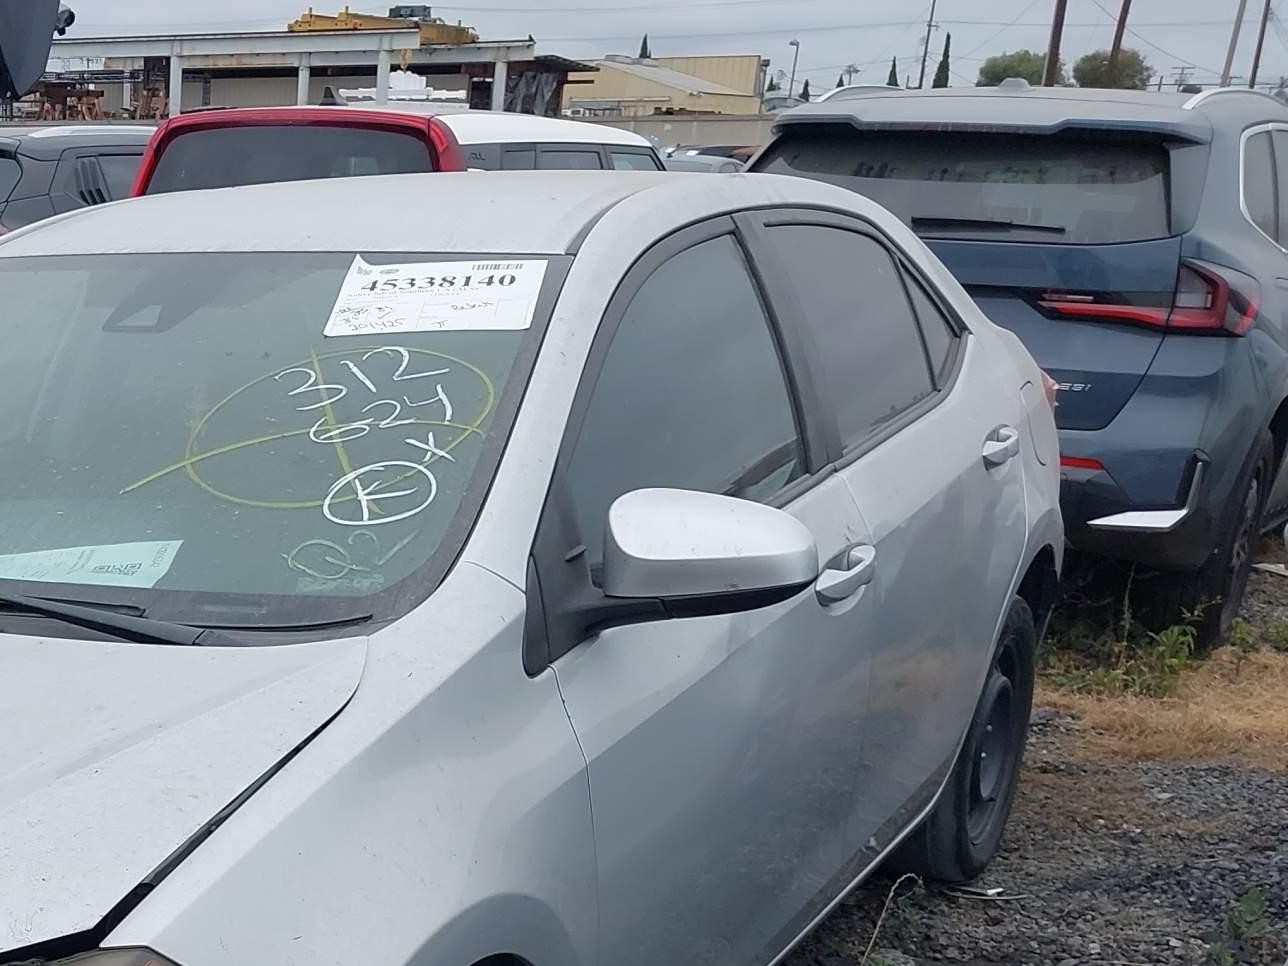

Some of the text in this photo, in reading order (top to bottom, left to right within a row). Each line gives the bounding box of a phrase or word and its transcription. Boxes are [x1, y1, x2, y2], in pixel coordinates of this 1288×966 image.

[361, 273, 517, 293] 45338140
[274, 346, 450, 410] 312
[309, 384, 453, 443] 624
